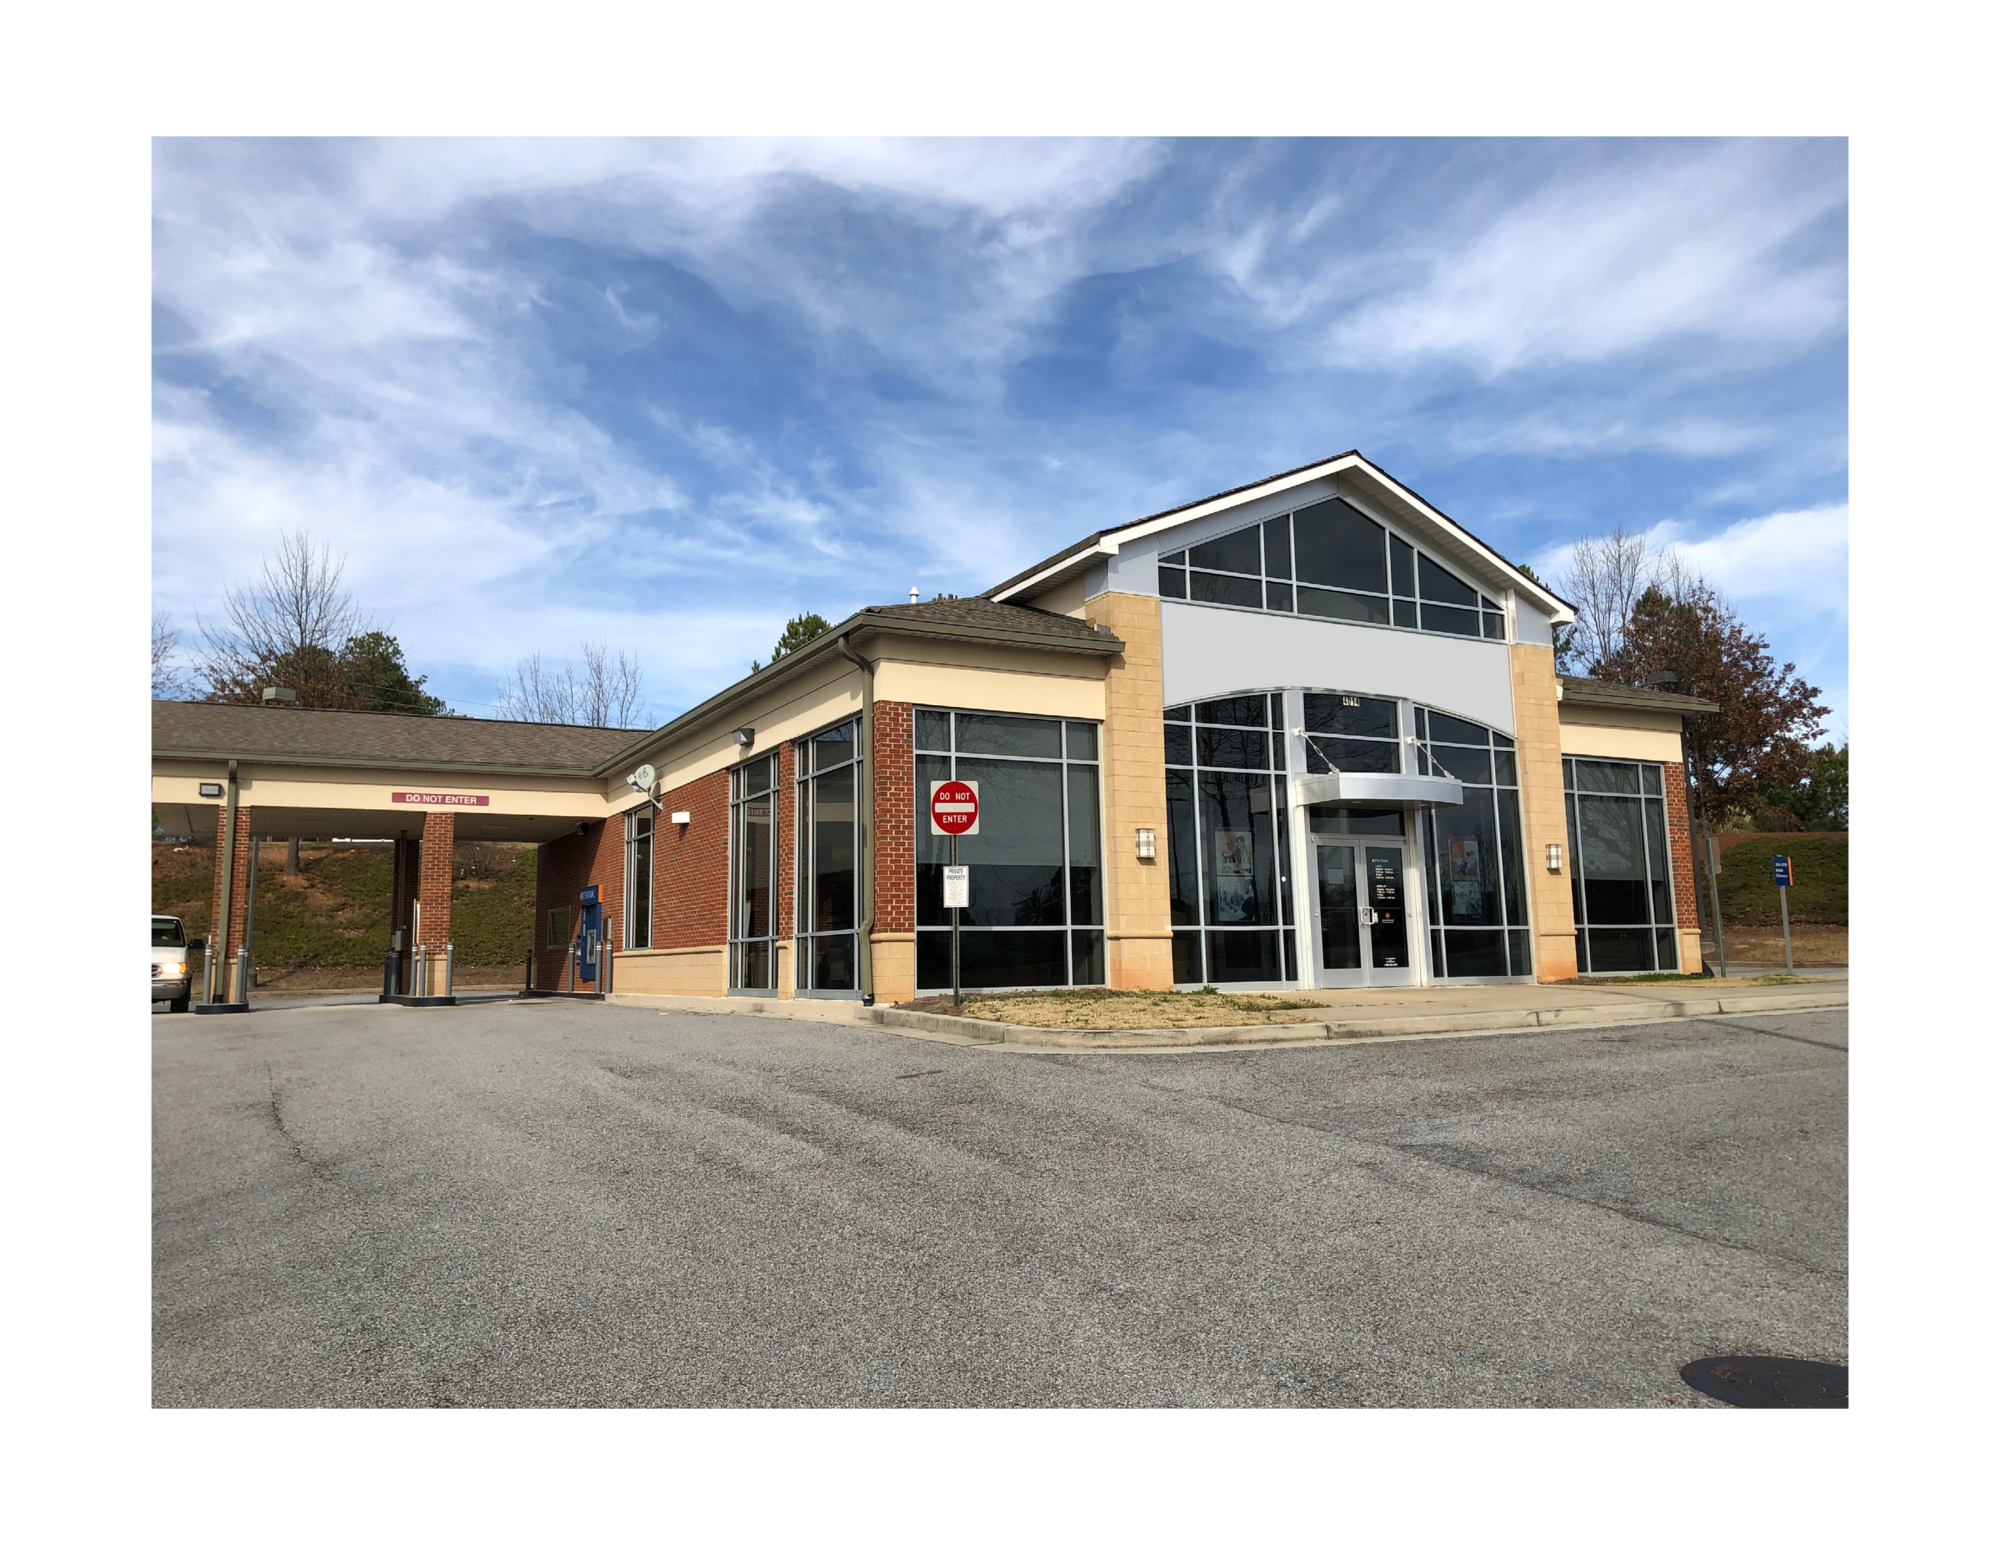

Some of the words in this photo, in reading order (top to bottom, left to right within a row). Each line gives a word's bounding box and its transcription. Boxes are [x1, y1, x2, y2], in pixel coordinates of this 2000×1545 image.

[405, 793, 421, 802] DO
[422, 794, 443, 803] NOT
[445, 795, 477, 804] ENTER
[939, 792, 950, 800] DO
[955, 792, 970, 800] NOT
[942, 814, 967, 823] ENTER
